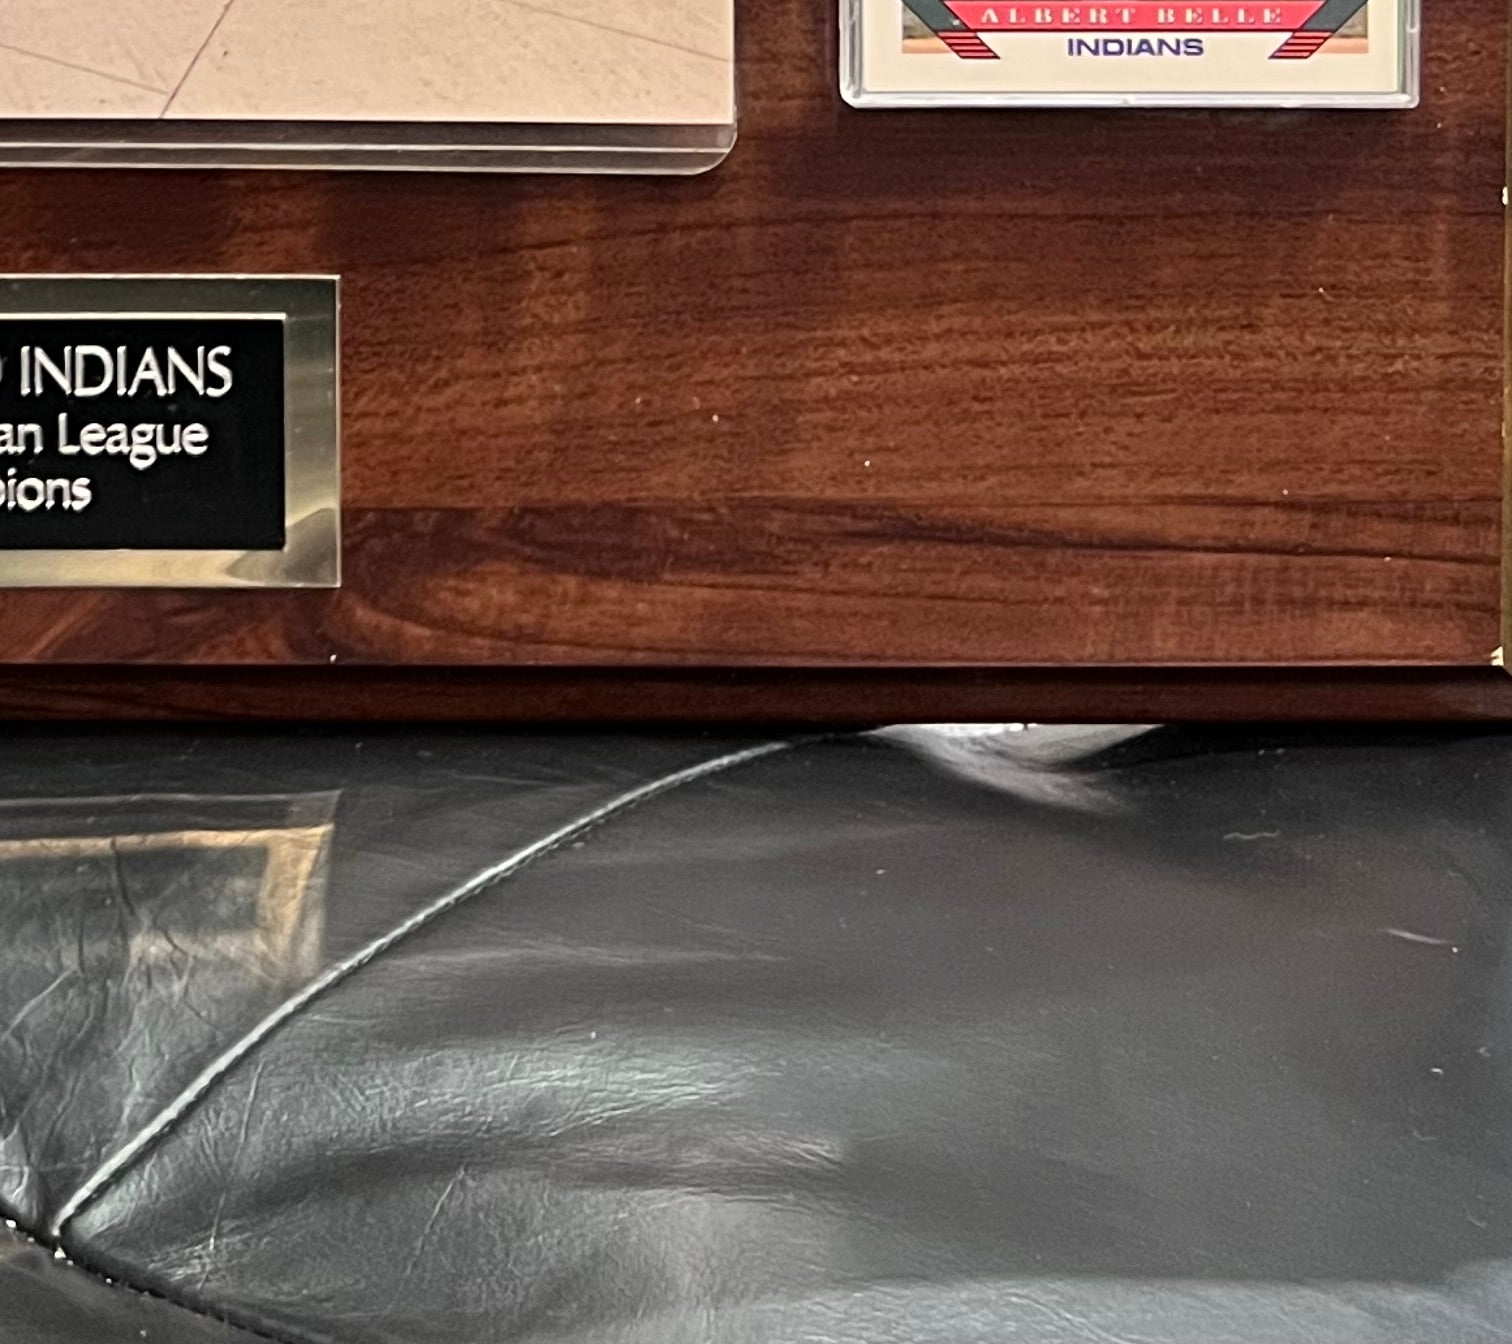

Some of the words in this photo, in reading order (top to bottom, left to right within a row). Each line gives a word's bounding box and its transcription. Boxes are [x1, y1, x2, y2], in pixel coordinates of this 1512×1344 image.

[981, 8, 1137, 25] ALBERT
[1157, 8, 1281, 25] BELLE
[1067, 37, 1204, 56] INDIANS
[19, 345, 233, 397] INDIANS
[58, 413, 209, 469] League
